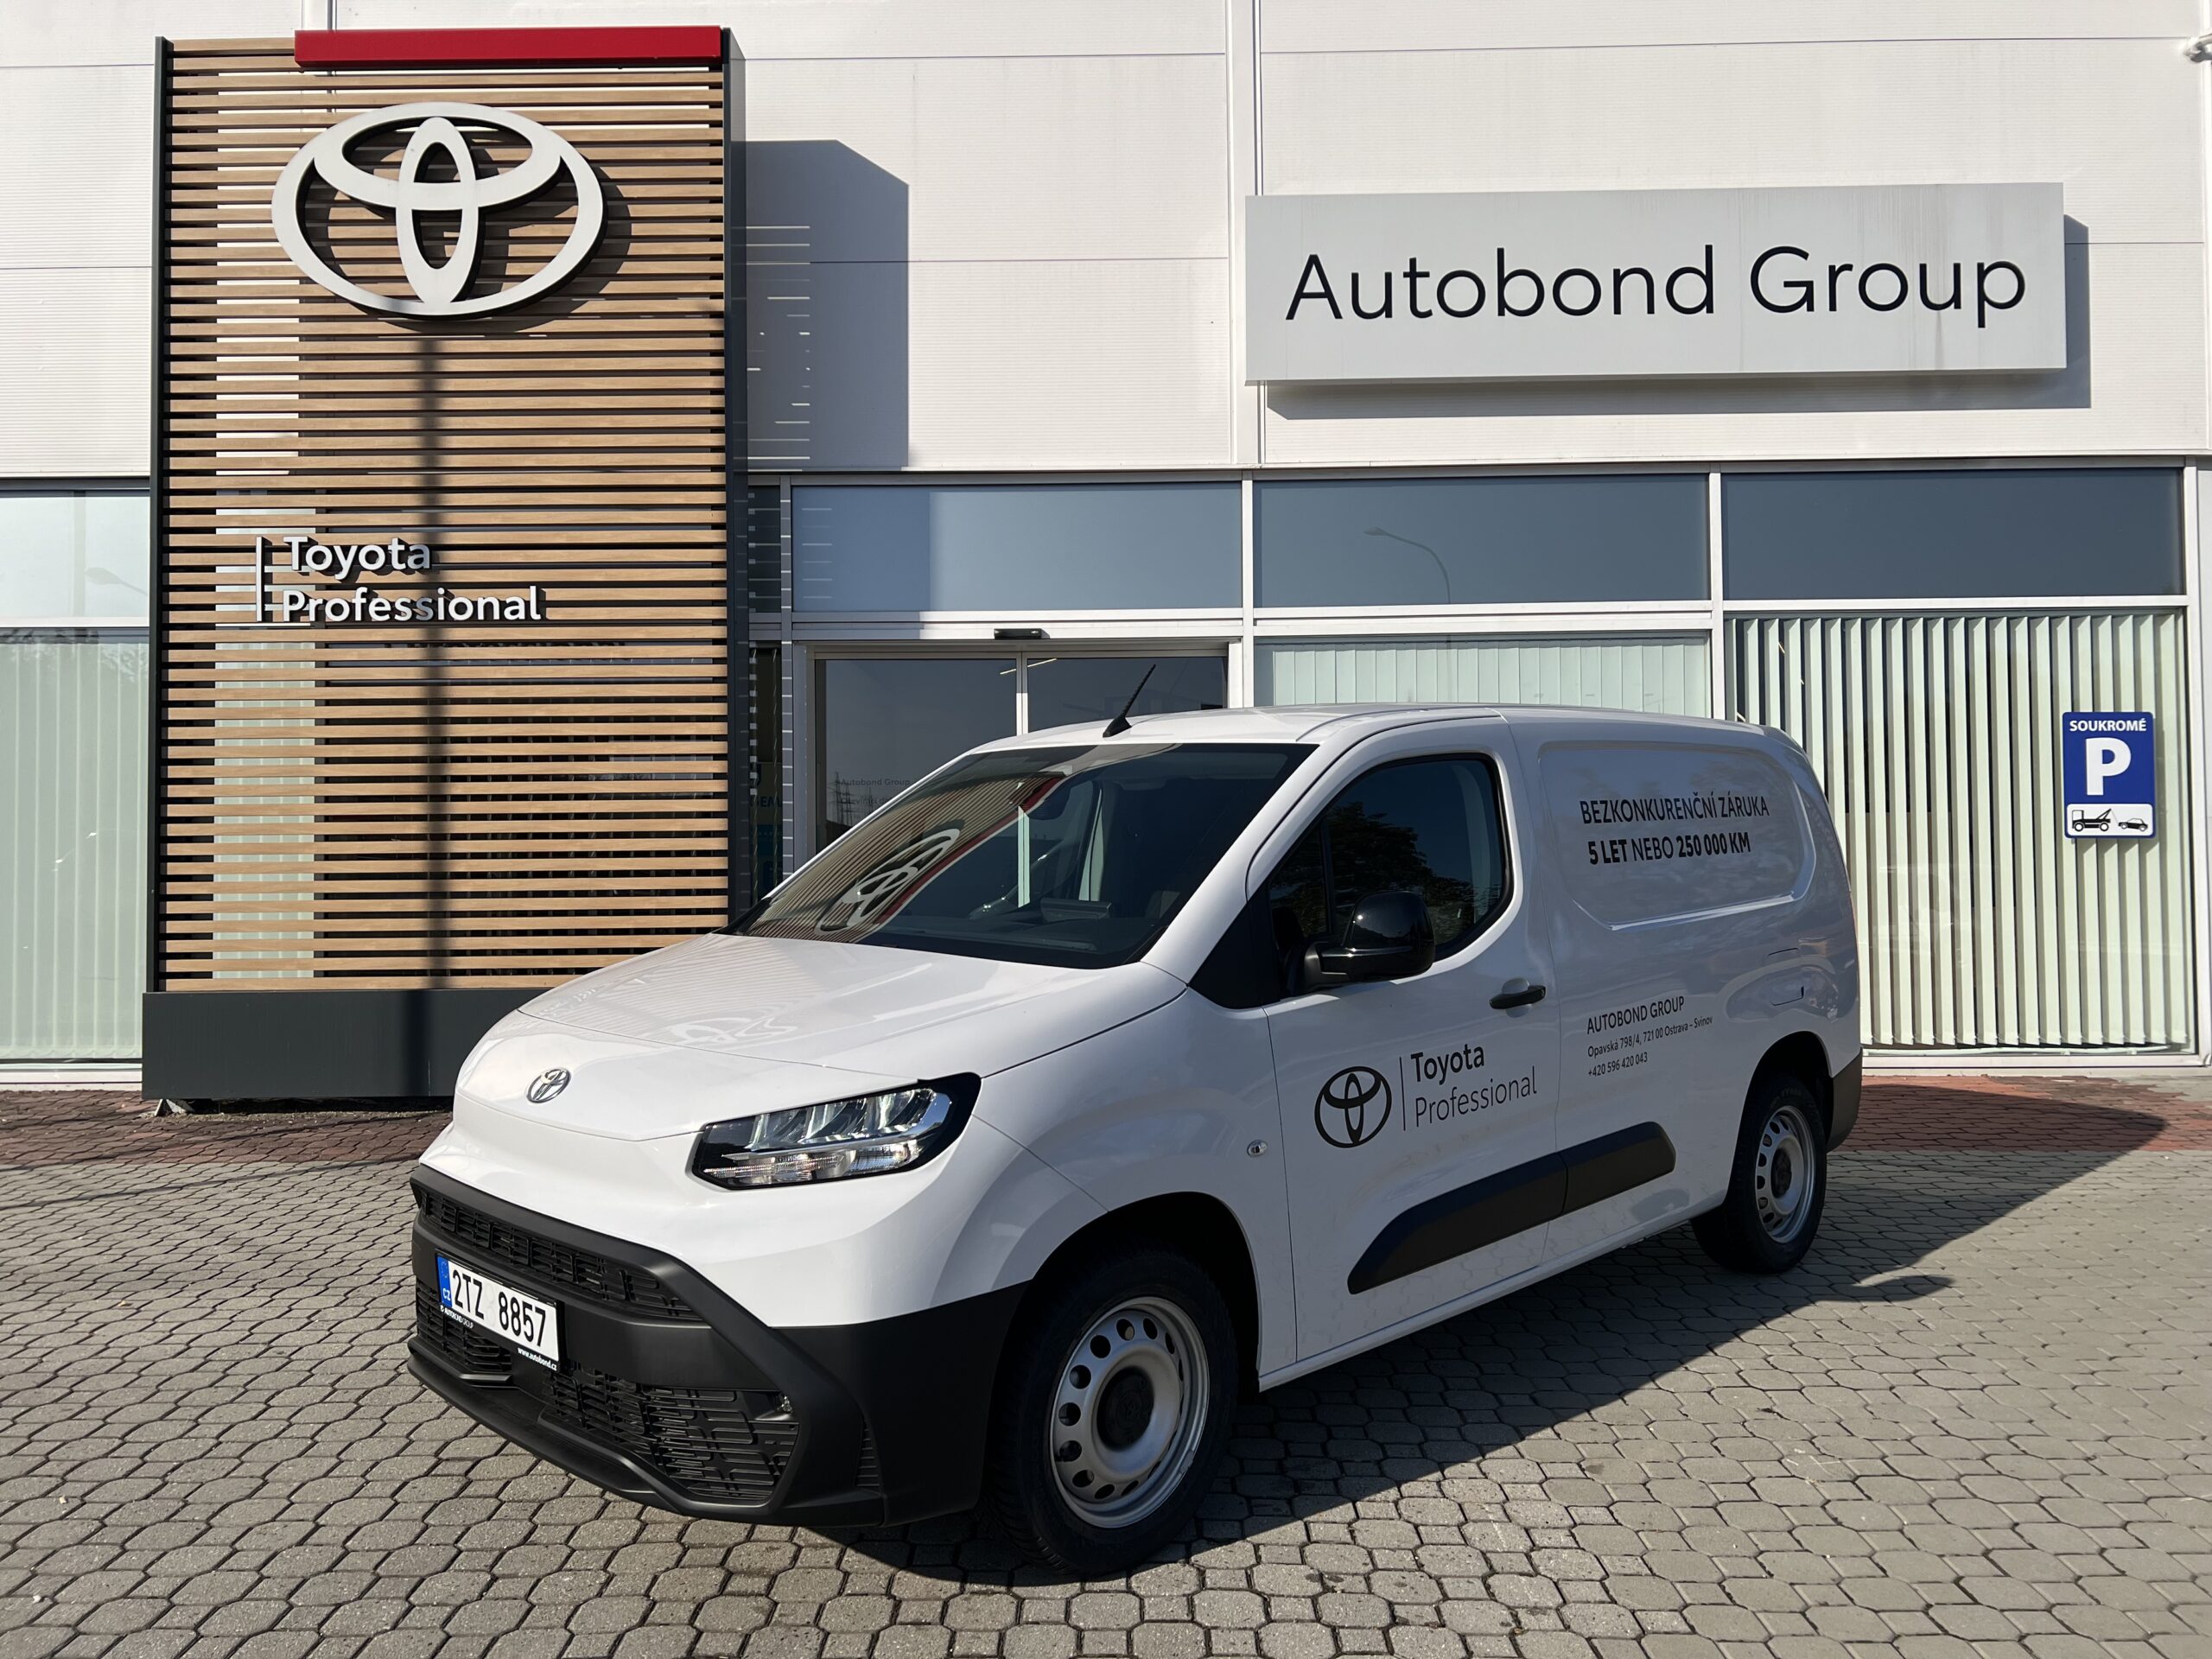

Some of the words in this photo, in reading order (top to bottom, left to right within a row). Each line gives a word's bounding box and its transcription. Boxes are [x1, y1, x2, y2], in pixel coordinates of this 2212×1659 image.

[1286, 245, 1714, 321] Autobond
[1750, 245, 2026, 328] Group
[283, 537, 430, 580] Toyota
[283, 586, 542, 622] Professional
[2069, 718, 2147, 732] SOUKROMÉ
[841, 778, 881, 786] Autobond
[884, 778, 911, 787] Group
[2085, 737, 2132, 796] P
[1580, 791, 1718, 824] BEZKONKURENČNÍ
[1719, 791, 1770, 817] ZÁRUKA
[1588, 841, 1599, 865] 5
[1600, 839, 1627, 863] LET
[1631, 836, 1674, 861] NEBO
[1675, 834, 1702, 857] 250
[1703, 833, 1727, 855] 000
[1729, 832, 1751, 853] KM
[1586, 1005, 1648, 1034] AUTOBOND
[1649, 995, 1685, 1018] GROUP
[1587, 1040, 1618, 1059] Opavská
[1664, 1022, 1688, 1036] Ostrava
[1694, 1015, 1713, 1028] Svinov
[1410, 1044, 1485, 1086] Toyota
[1588, 1063, 1606, 1077] +420
[1607, 1059, 1620, 1073] 596
[1621, 1055, 1634, 1068] 420
[1635, 1052, 1648, 1065] 043
[1415, 1065, 1537, 1127] Professional
[442, 1287, 451, 1301] CZ
[453, 1269, 484, 1319] 2TZ
[498, 1291, 546, 1348] 8857
